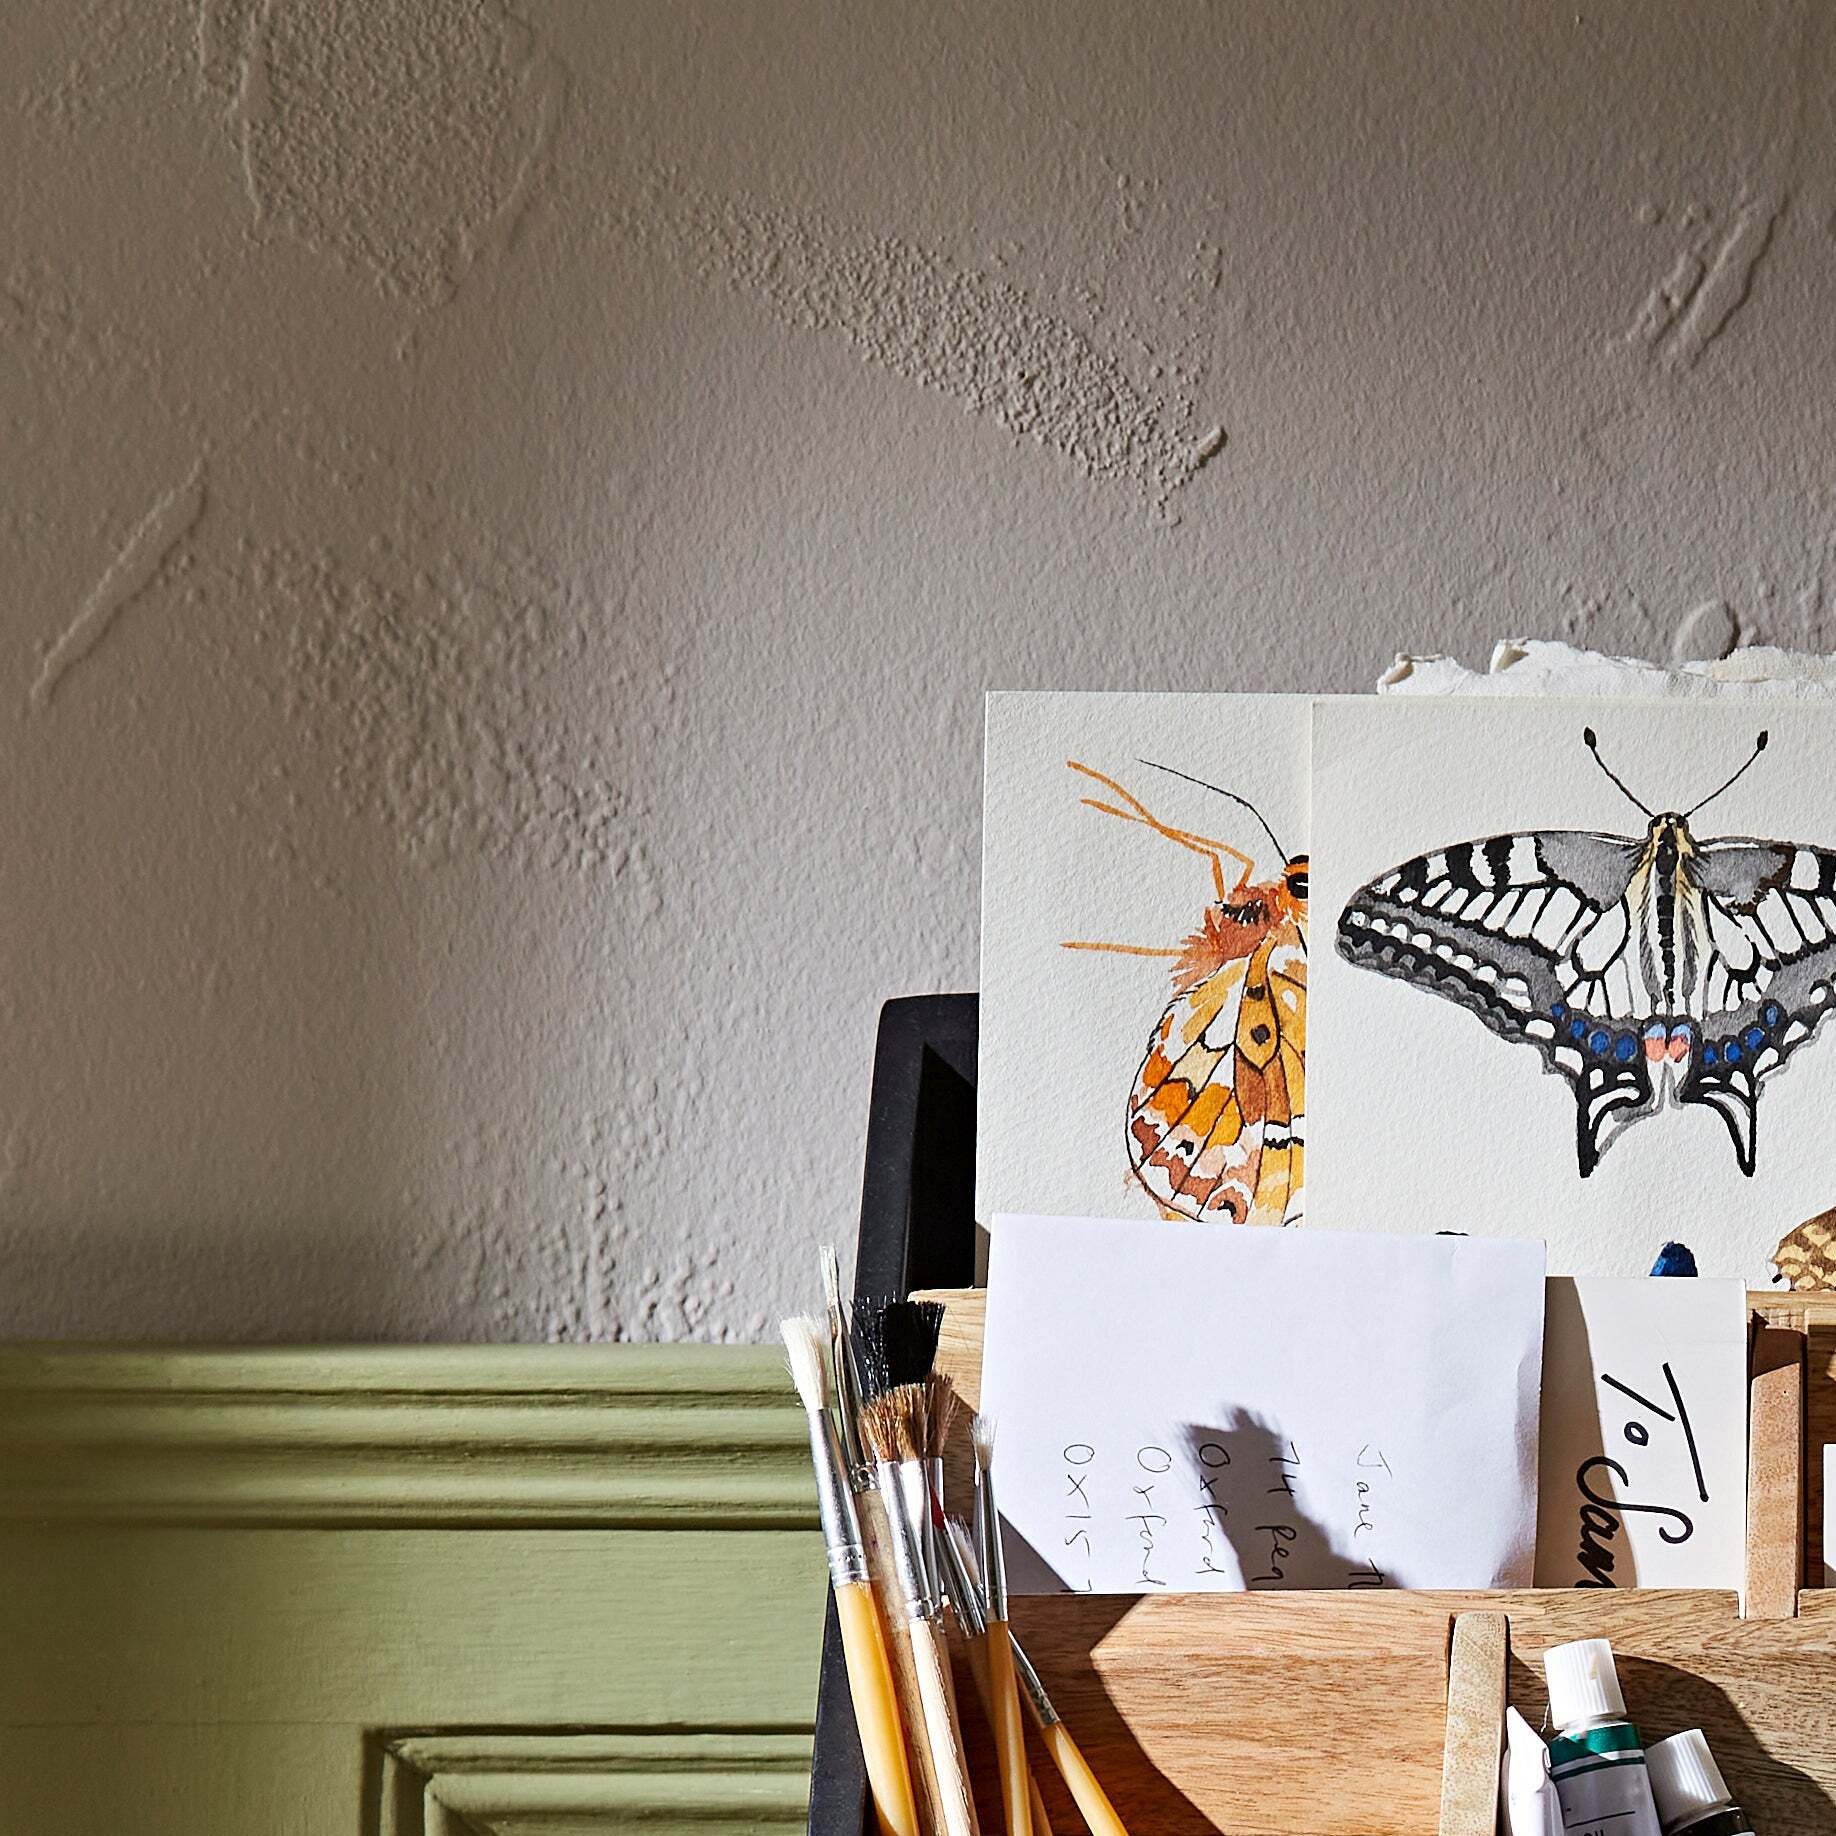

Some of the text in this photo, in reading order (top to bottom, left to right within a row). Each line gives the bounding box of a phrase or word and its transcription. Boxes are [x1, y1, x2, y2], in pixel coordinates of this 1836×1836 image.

[1267, 1441, 1300, 1497] 74
[1601, 1362, 1709, 1502] To
[1194, 1443, 1231, 1574] Oxford
[1354, 1444, 1392, 1537] Jane
